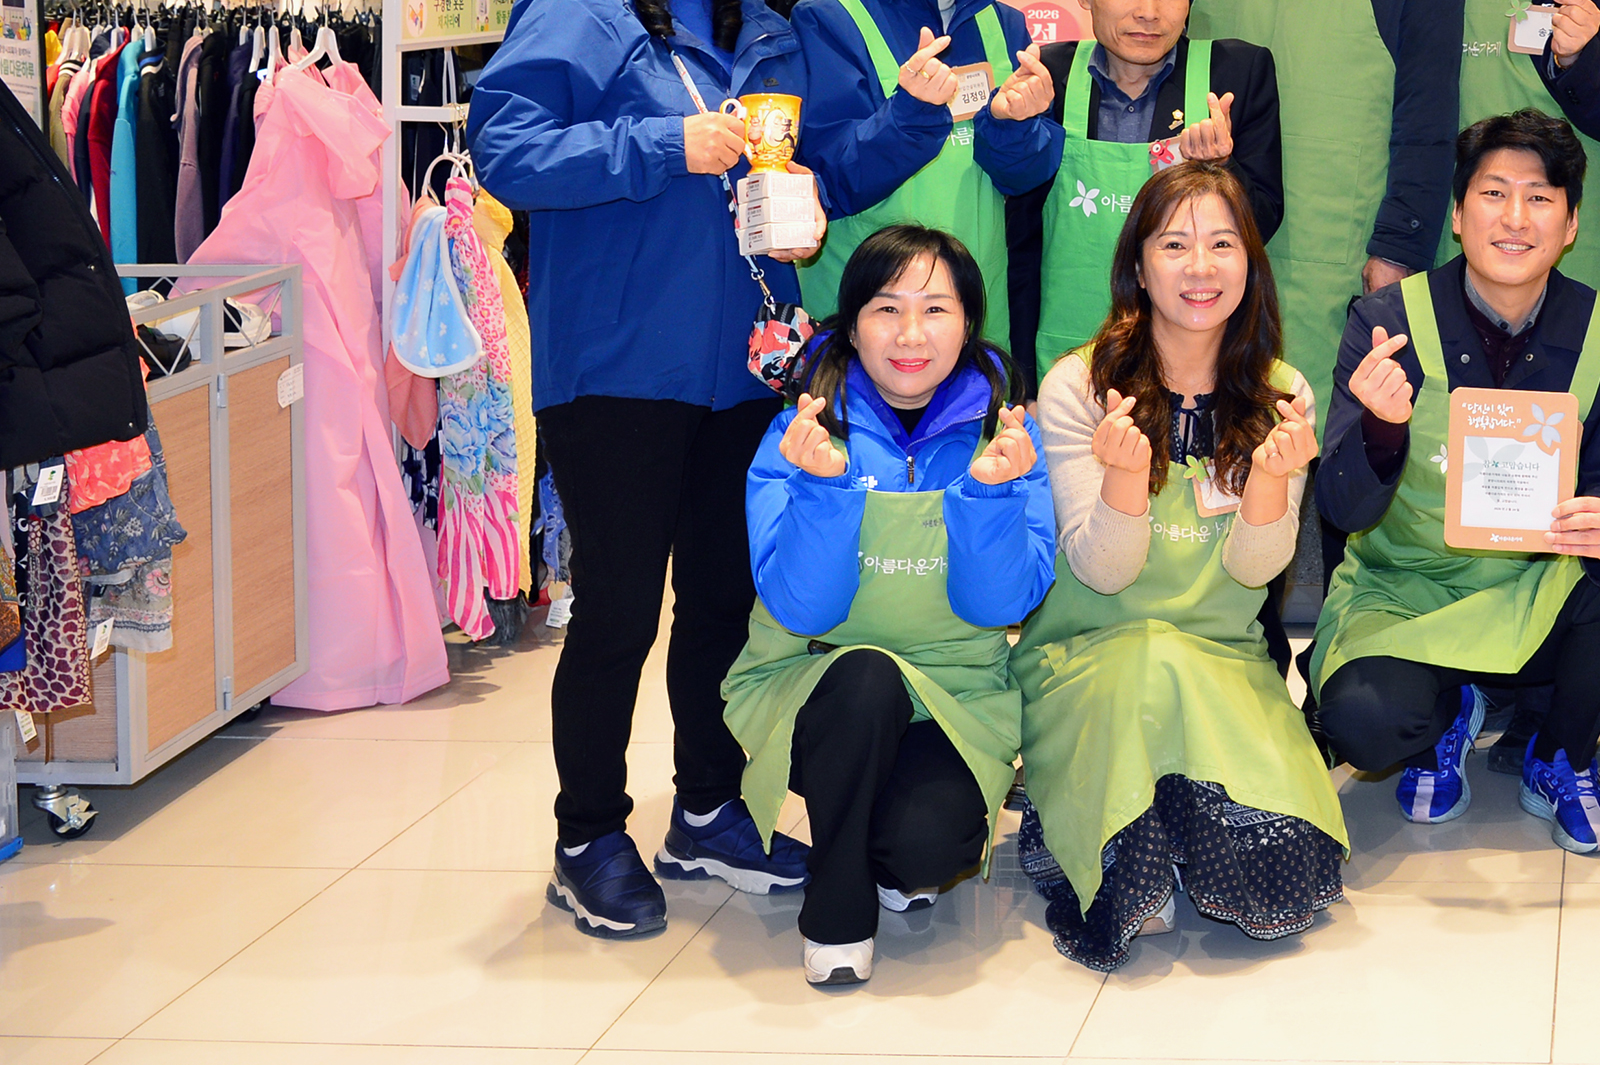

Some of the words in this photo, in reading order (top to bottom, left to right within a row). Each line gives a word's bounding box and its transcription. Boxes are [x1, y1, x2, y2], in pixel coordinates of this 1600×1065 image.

[1027, 9, 1060, 20] 2026
[1462, 41, 1502, 57] 다운가게
[961, 90, 987, 105] 김정임
[1101, 193, 1134, 214] 아름
[1496, 403, 1514, 417] 있어
[1502, 461, 1540, 472] 고맙습니다
[864, 556, 949, 576] 아름다운가
